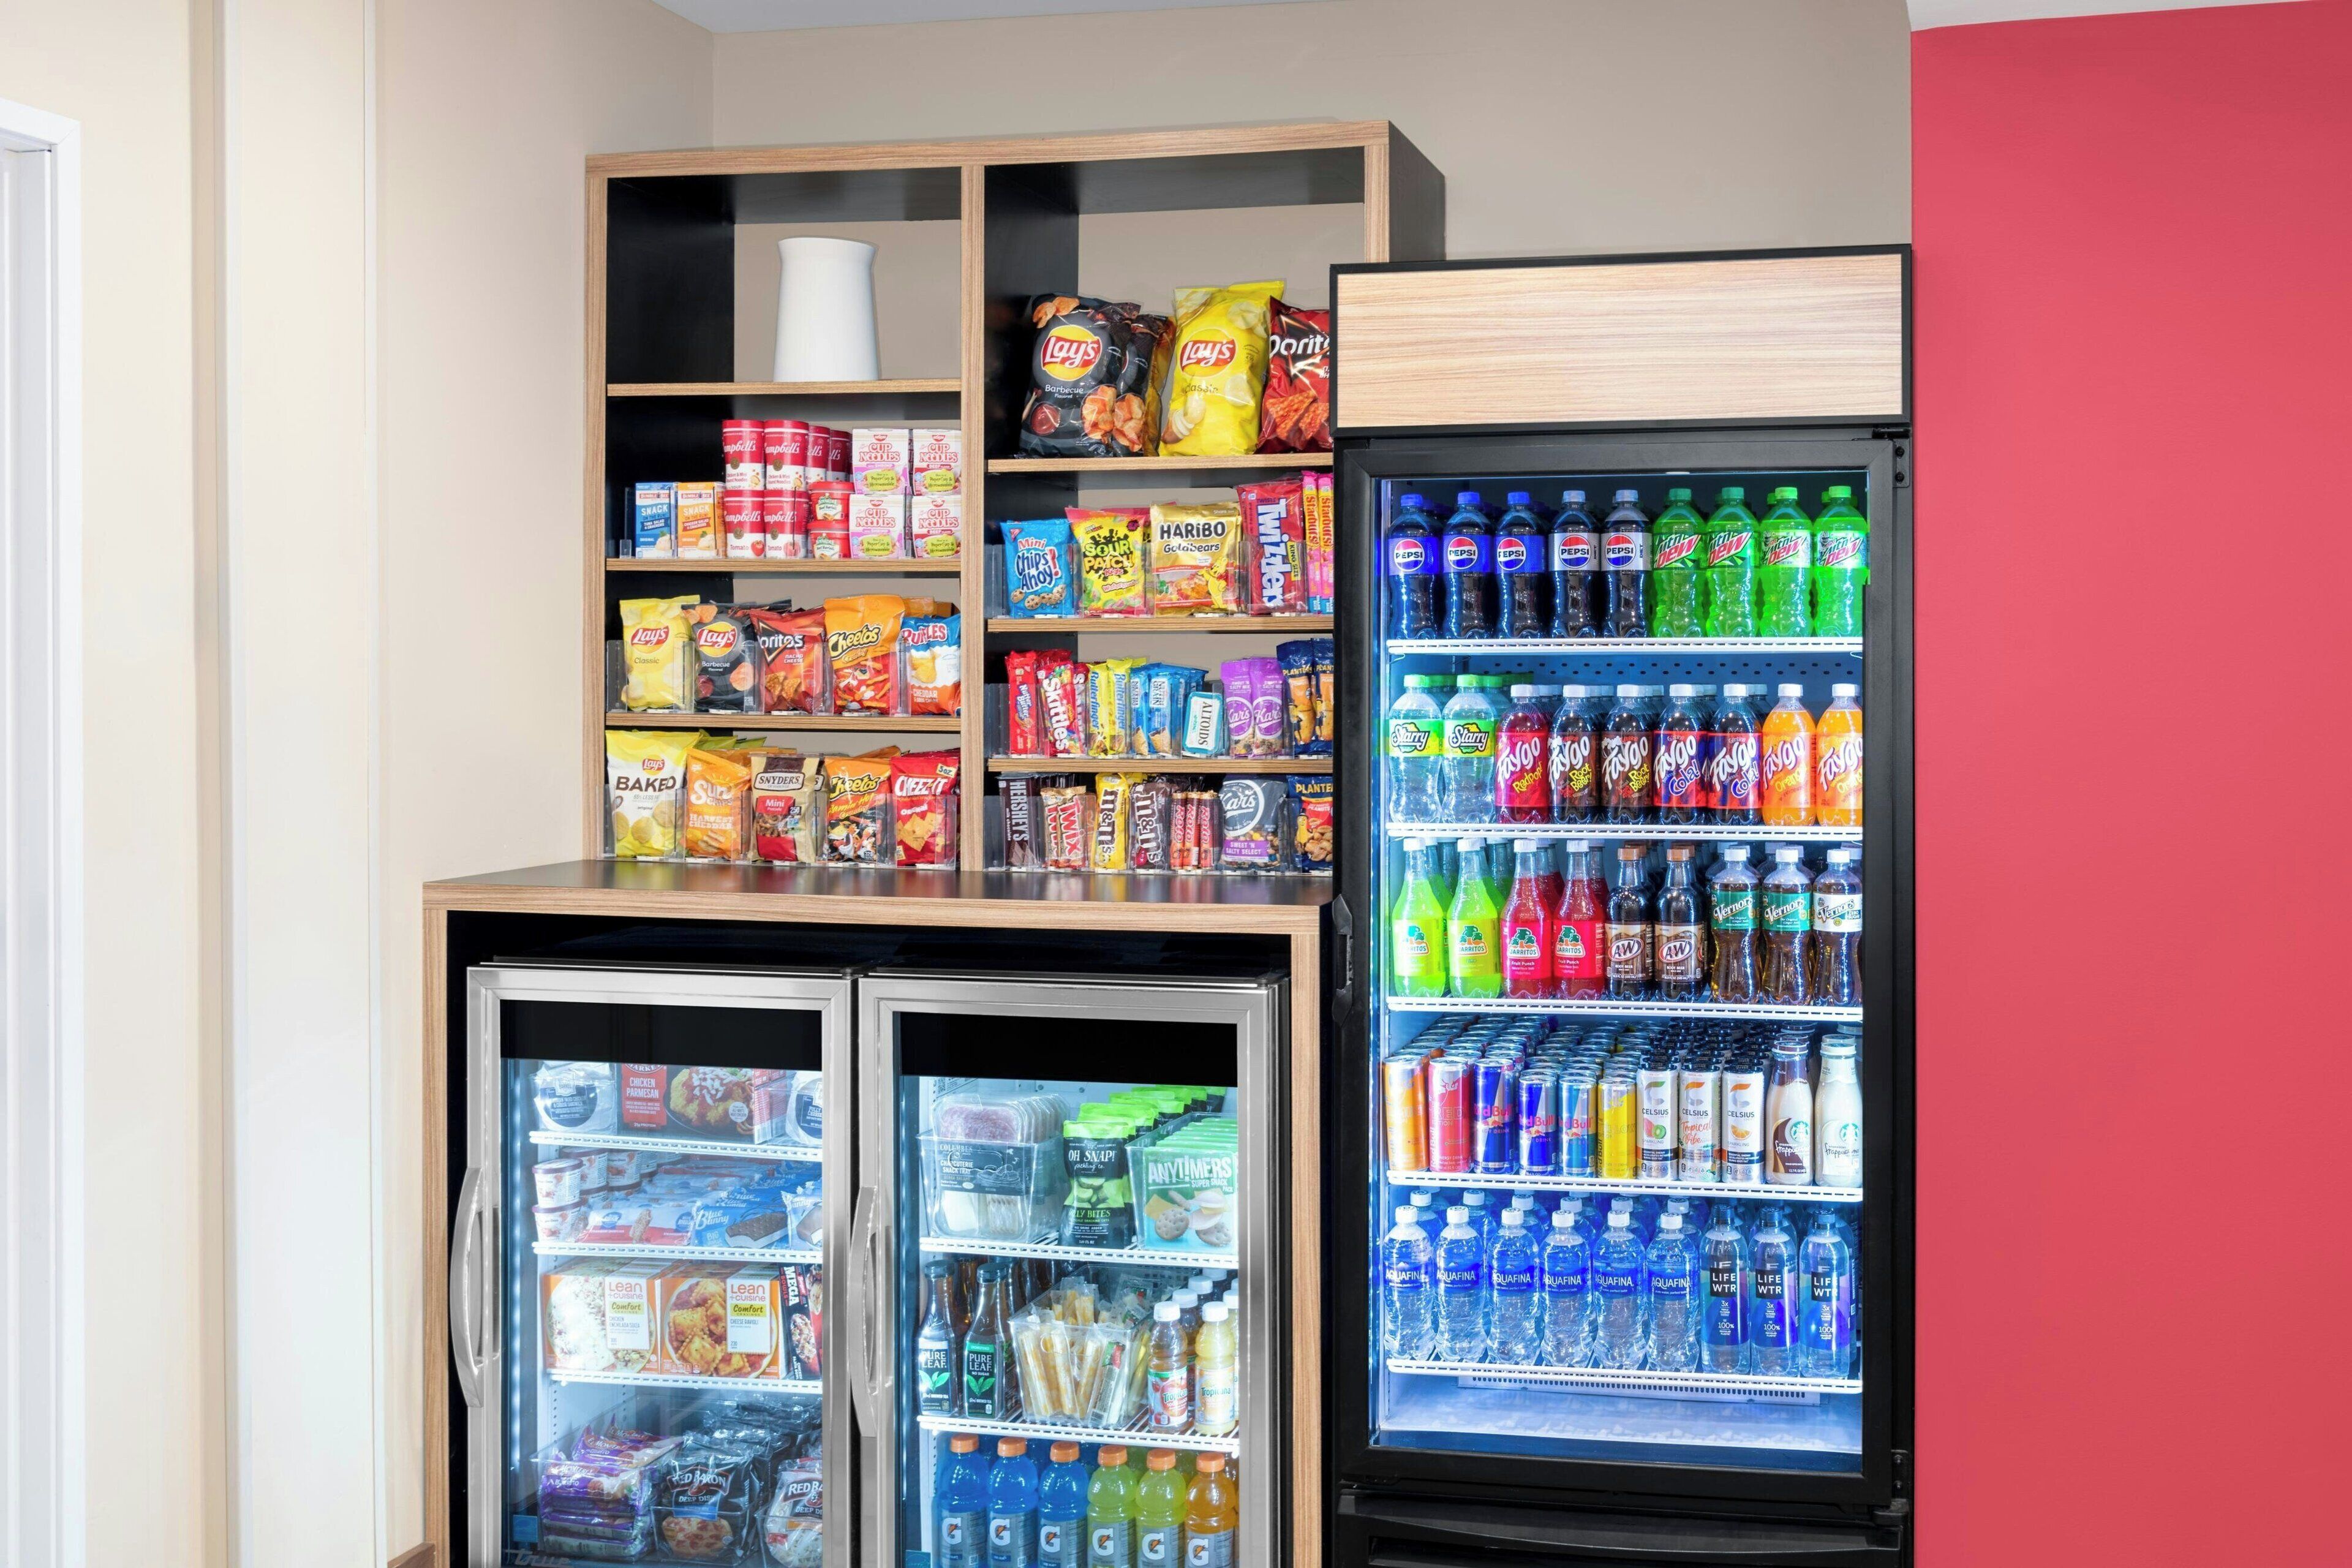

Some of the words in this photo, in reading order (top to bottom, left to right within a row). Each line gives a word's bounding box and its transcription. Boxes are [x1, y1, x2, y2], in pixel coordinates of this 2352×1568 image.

[1045, 336, 1102, 369] Lay's
[1182, 338, 1235, 369] Lay's
[1045, 384, 1084, 394] Barbecue
[869, 443, 892, 453] CUP
[928, 443, 951, 452] CUP
[859, 452, 901, 463] NOODLES
[919, 452, 958, 463] NOODLES
[641, 505, 668, 516] SNACK
[684, 505, 710, 516] SNACK
[865, 508, 888, 518] CUP
[928, 508, 951, 518] CUP
[855, 517, 896, 528] NOODLES
[919, 518, 959, 529] NOODLES
[1018, 538, 1046, 550] Mini
[1085, 540, 1131, 557] SOUR
[1164, 541, 1220, 554] Goldbears
[1016, 552, 1049, 576] Chips
[1084, 554, 1134, 573] PATCH
[633, 627, 667, 645] Lay's
[699, 629, 734, 648] Lay's
[829, 625, 880, 657] Cheetos
[1090, 671, 1101, 729] Butterfinger
[1115, 674, 1126, 730] Butterfinger
[1043, 677, 1070, 751] Skittles
[1198, 701, 1213, 746] ALTOIDS
[1392, 725, 1429, 750] Starry
[1451, 725, 1489, 750] Starry
[644, 759, 664, 771] Lay's
[1497, 736, 1540, 790] Faygo
[1548, 736, 1590, 790] Faygo
[1602, 737, 1649, 790] Faygo
[1654, 735, 1697, 789] Faygo
[1709, 736, 1757, 791] Faygo
[1763, 736, 1806, 790] Faygo
[1569, 763, 1592, 781] Root
[1628, 763, 1650, 782] Root
[1668, 760, 1700, 795] Cola!
[616, 775, 676, 793] BAKED
[759, 775, 800, 785] SNYDER'S
[1570, 774, 1593, 792] Beer!
[1629, 773, 1649, 793] Beer!
[1731, 761, 1760, 799] Cola!
[691, 779, 733, 805] Sun
[1010, 781, 1029, 842] HERSHEY'S
[1058, 797, 1082, 856] TWIX
[1714, 896, 1753, 922] Vernors
[1765, 898, 1804, 925] Vernors
[1817, 899, 1855, 923] Vernors
[1613, 940, 1635, 959] A&W
[1664, 941, 1687, 960] A&W
[630, 1077, 655, 1087] CHICKEN
[626, 1088, 659, 1098] PARMESAN
[1492, 1106, 1513, 1117] Bull
[1536, 1115, 1555, 1126] Bull
[1572, 1118, 1592, 1129] Bull
[1681, 1118, 1713, 1133] Tropical
[1683, 1133, 1702, 1145] Vibe
[1068, 1150, 1080, 1162] OH
[1084, 1149, 1115, 1162] SNAP!
[940, 1159, 973, 1168] CHARCUTERIE
[1191, 1180, 1210, 1188] SUPER
[1385, 1269, 1424, 1283] AQUAFINA
[1436, 1270, 1476, 1283] AQUAFINA
[1492, 1273, 1531, 1286] AQUAFINA
[1542, 1275, 1581, 1287] AQUAFINA
[1595, 1276, 1634, 1287] AQUAFINA
[1712, 1273, 1736, 1282] LIFE
[1757, 1275, 1782, 1283] LIFE
[1814, 1277, 1838, 1286] LIFE
[609, 1281, 643, 1293] Lean
[731, 1284, 765, 1294] Lean
[1651, 1277, 1691, 1290] AQUAFINA
[1713, 1284, 1737, 1292] WTR
[1757, 1285, 1782, 1294] WTR
[1814, 1288, 1838, 1297] WTR
[612, 1302, 641, 1310] Comfort
[733, 1304, 763, 1313] Comfort
[922, 1351, 946, 1360] PURE
[969, 1353, 992, 1362] PURE
[673, 1471, 693, 1485] RED
[788, 1482, 811, 1496] RED
[942, 1517, 962, 1544] G
[989, 1519, 1010, 1546] G
[1041, 1526, 1060, 1553] G
[1093, 1528, 1114, 1556] G
[1142, 1532, 1164, 1560] G
[1188, 1539, 1209, 1566] G
